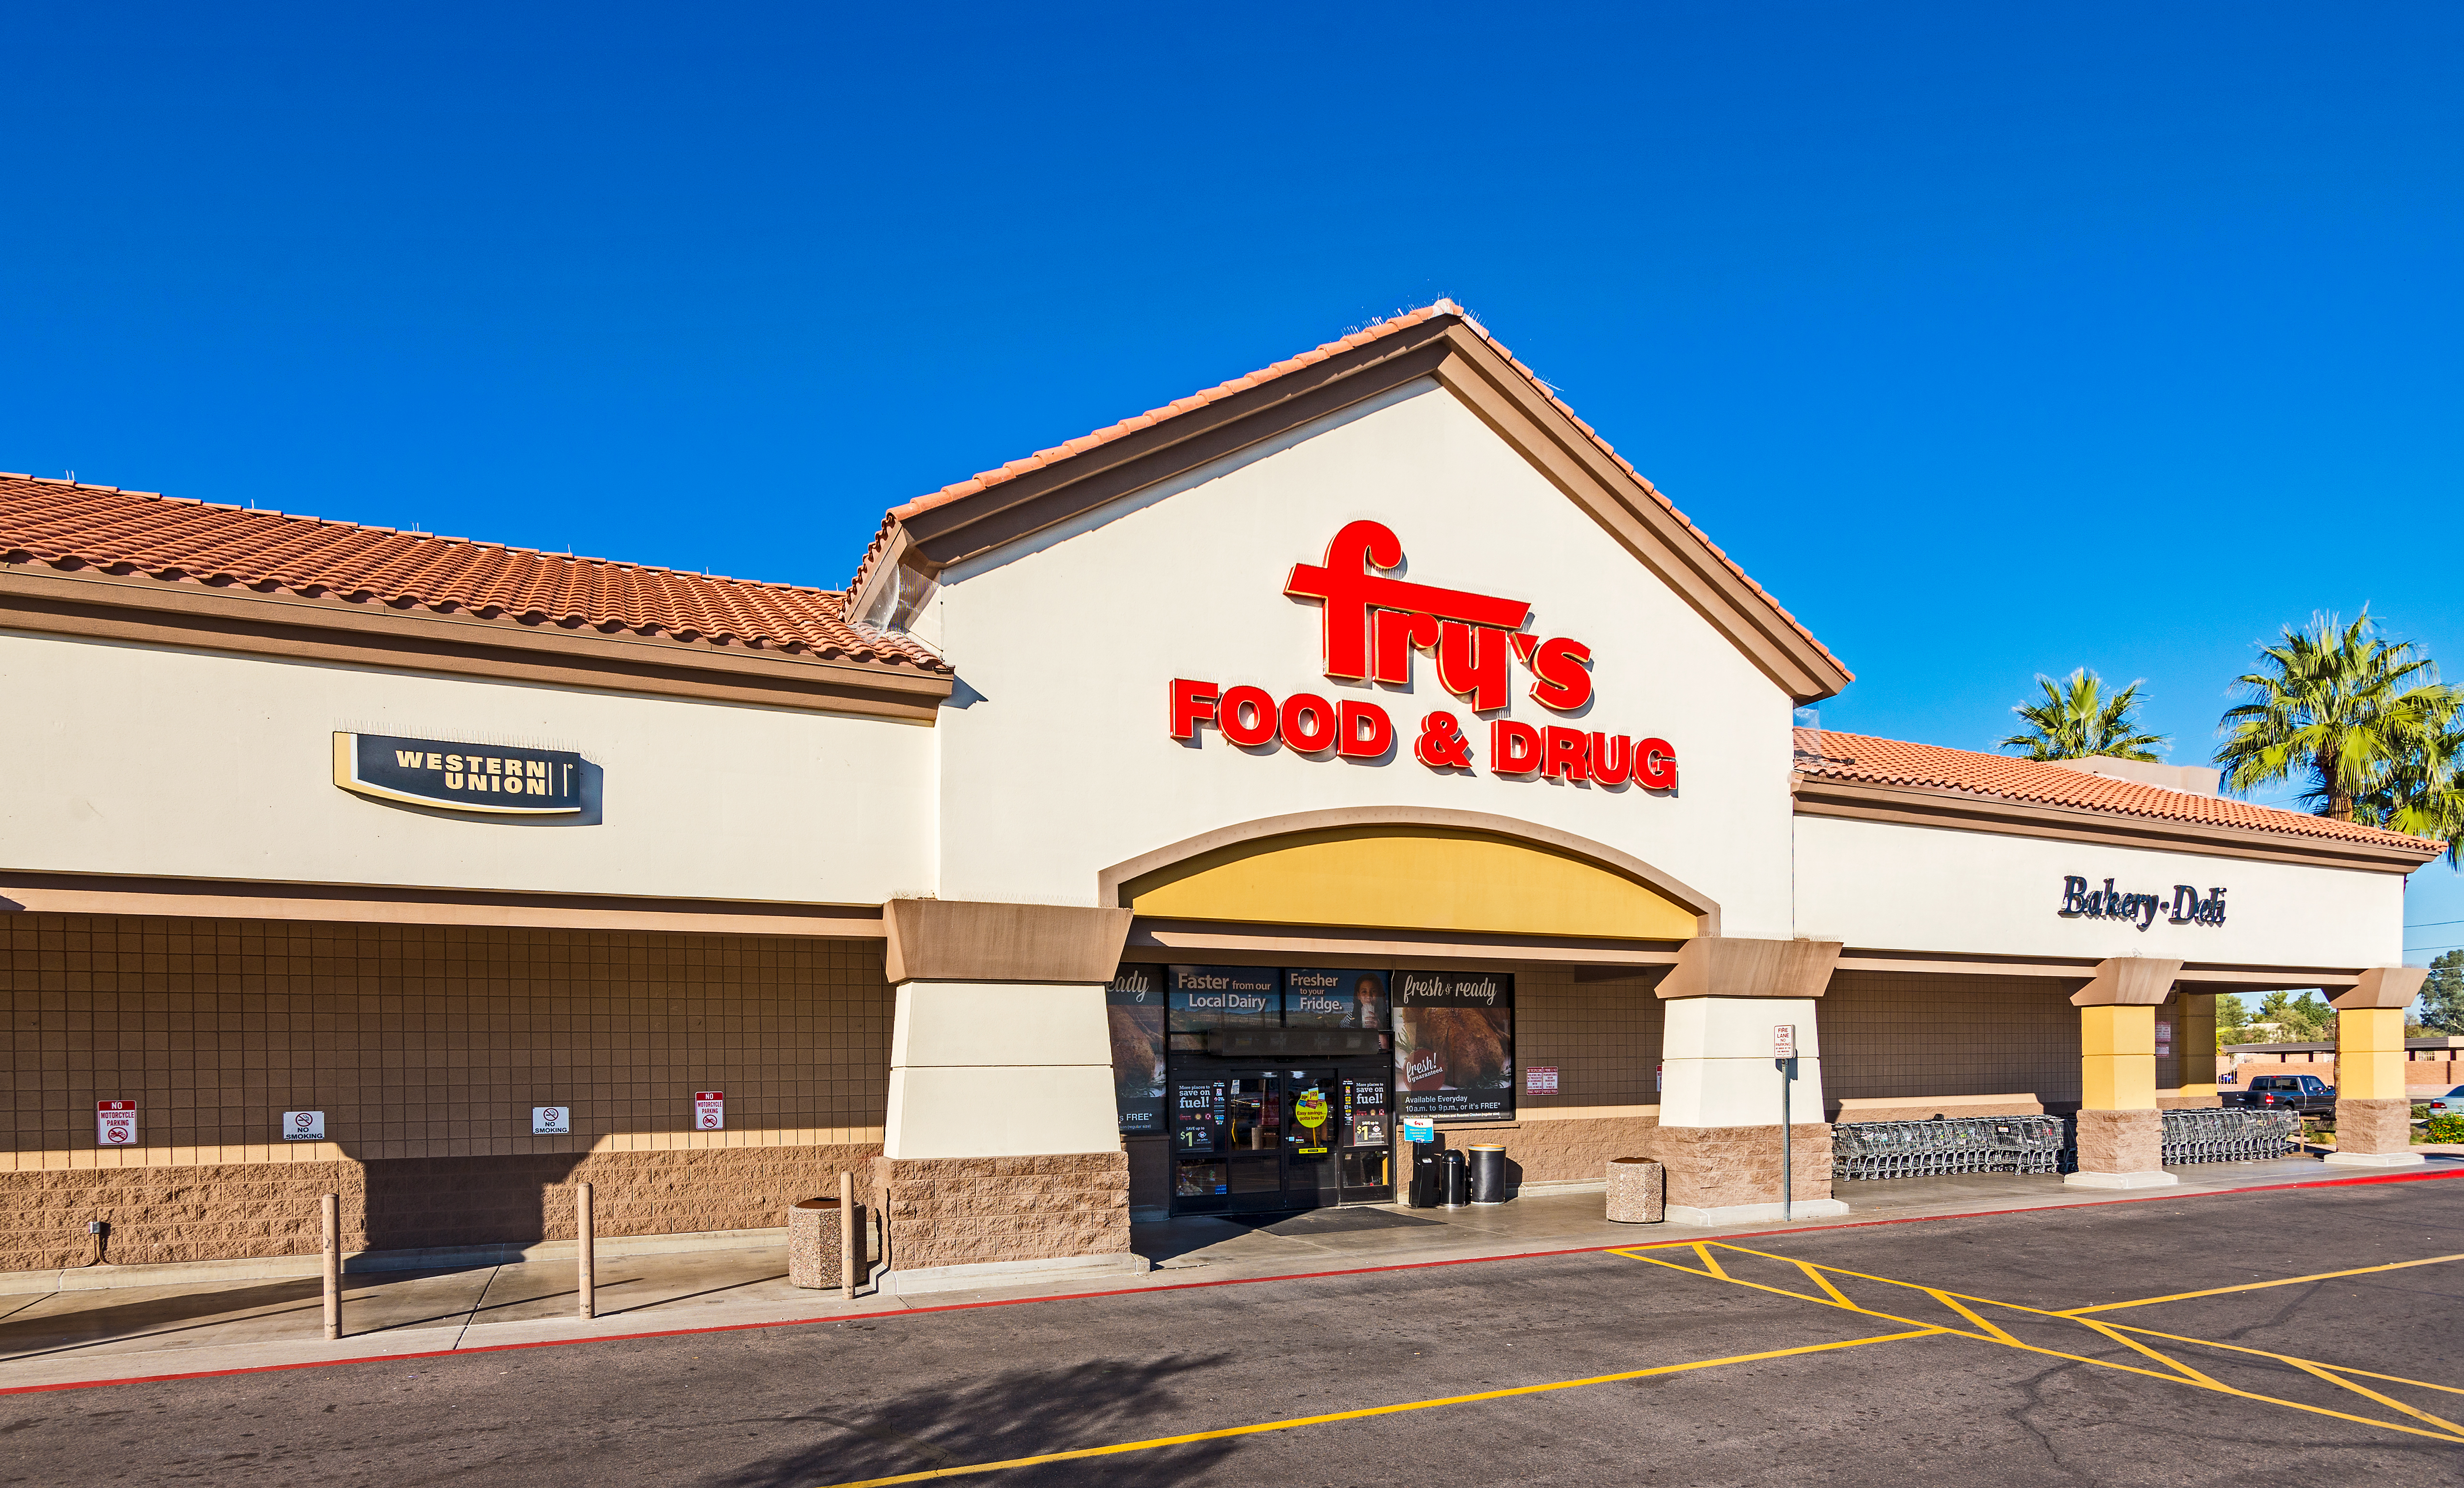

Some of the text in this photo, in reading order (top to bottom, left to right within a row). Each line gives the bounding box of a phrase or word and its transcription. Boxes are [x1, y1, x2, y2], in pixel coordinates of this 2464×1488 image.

[1283, 520, 1592, 712] fry's
[1170, 677, 1677, 790] FOOD & DRUG
[395, 750, 545, 778] WESTERN
[445, 772, 545, 796] UNION
[1102, 970, 1149, 1002] eady
[1178, 973, 1229, 989] Faster
[1232, 981, 1254, 990] from
[1291, 973, 1338, 986] Fresher
[1404, 975, 1497, 1005] fresh & ready
[1189, 993, 1266, 1011] Local Dairy
[1300, 997, 1342, 1013] Fridge.
[1407, 1052, 1436, 1082] fresh!
[1412, 1067, 1443, 1082] guaranteed
[1180, 1096, 1209, 1108] fuel!
[1357, 1093, 1383, 1104] fuel!
[1438, 1095, 1467, 1103] Everyday
